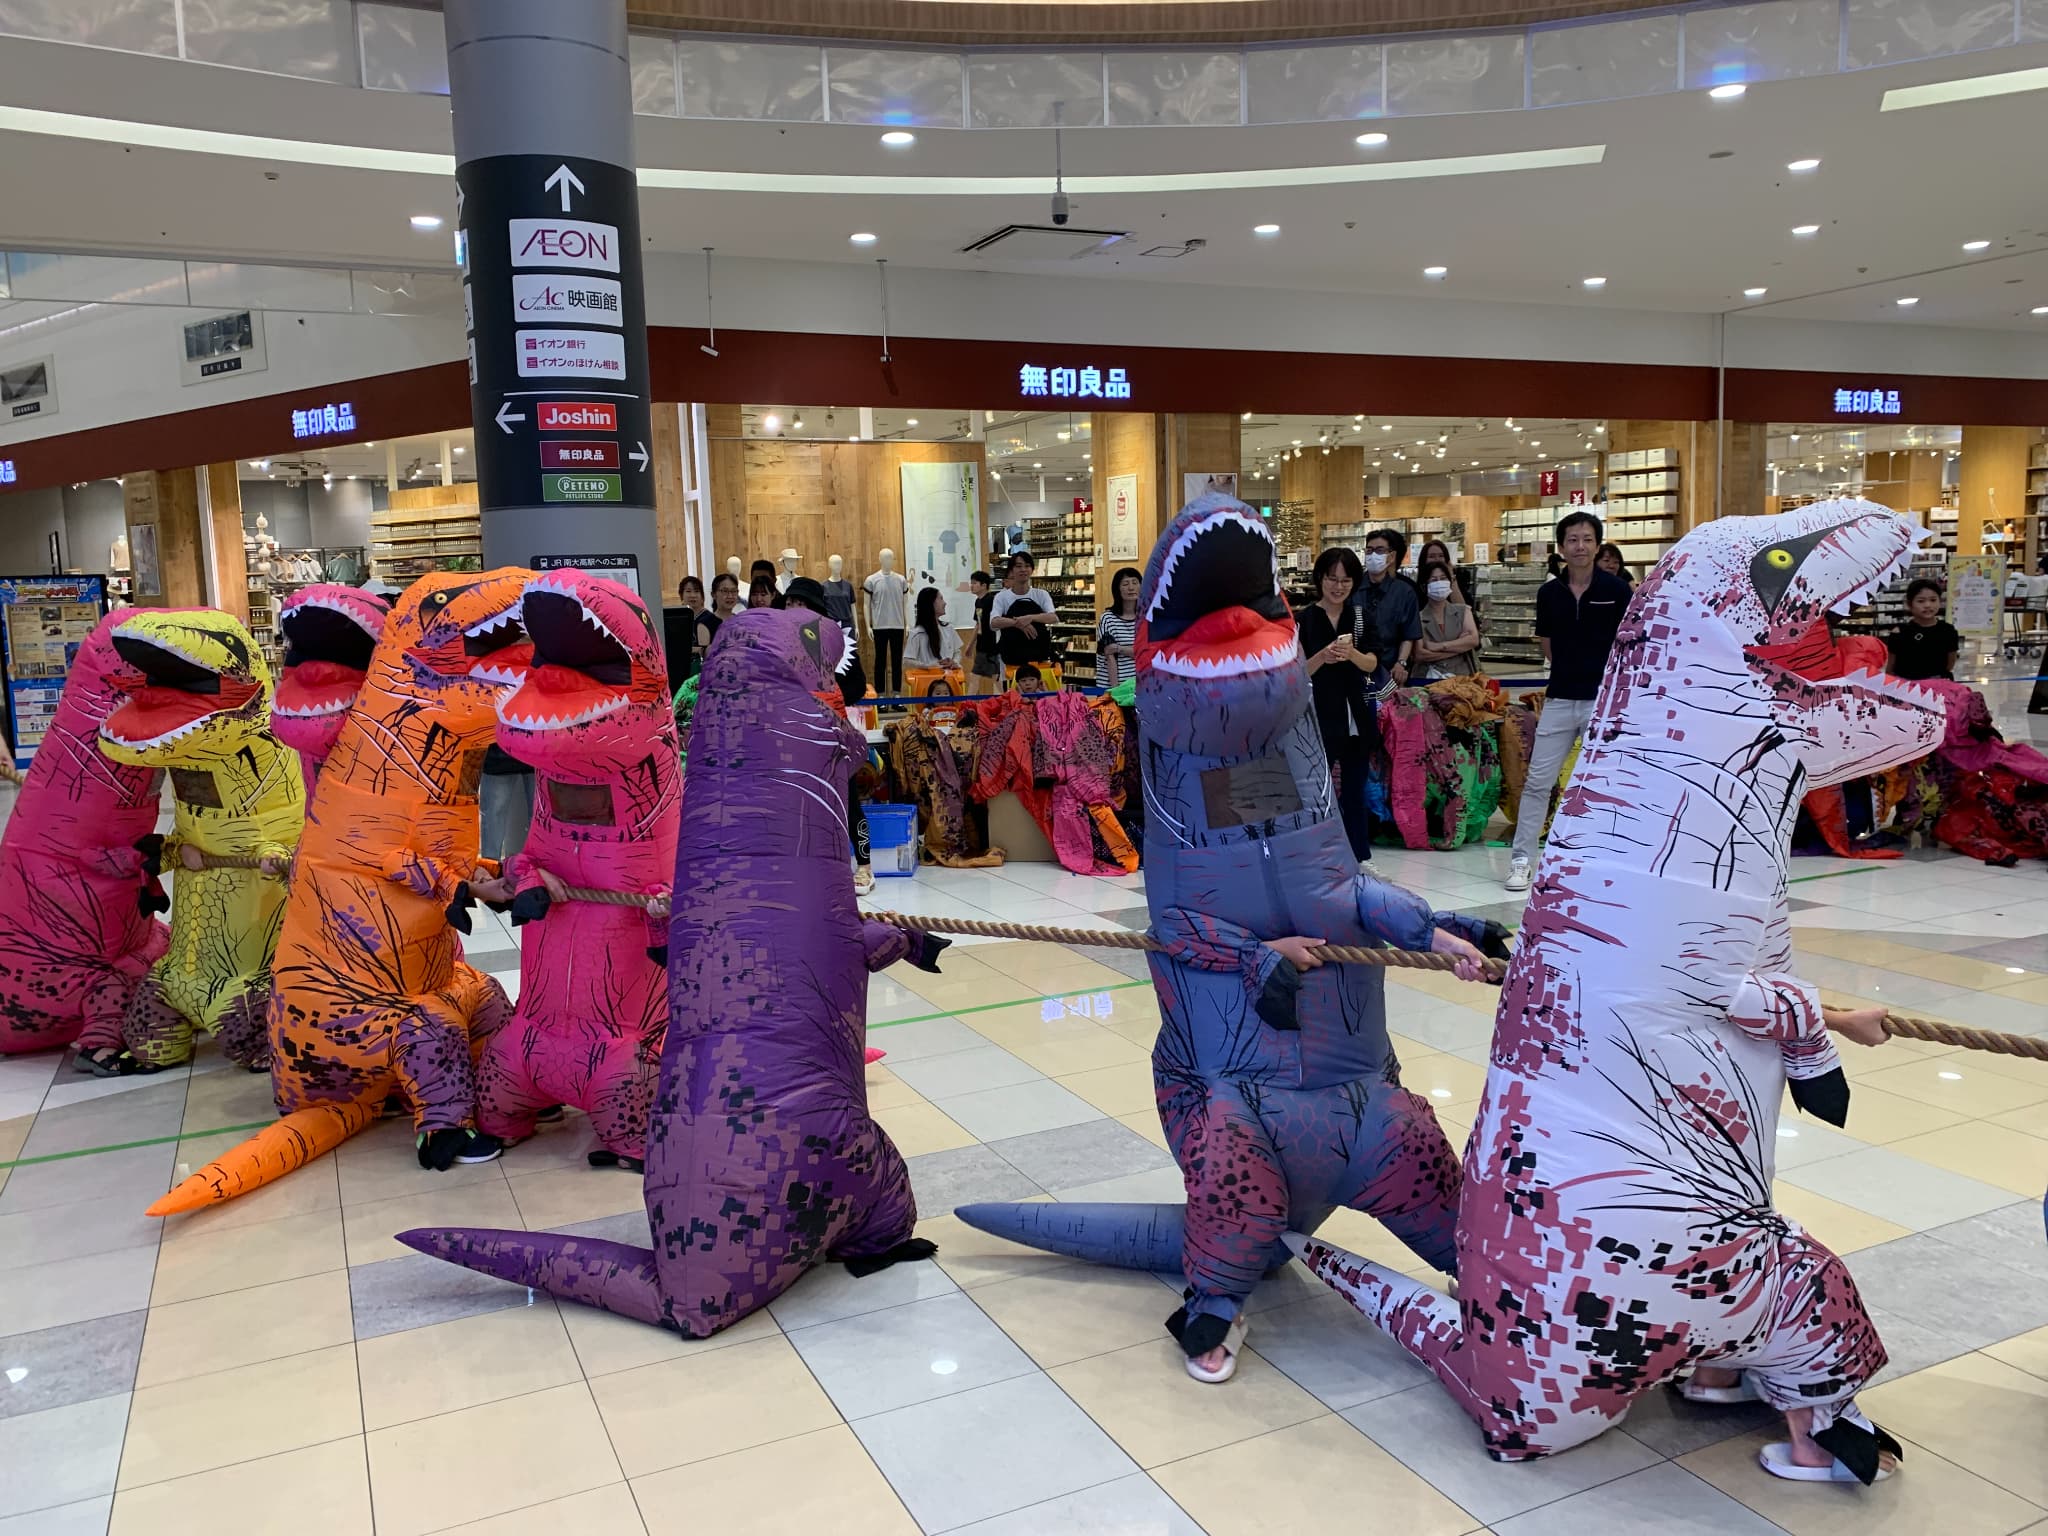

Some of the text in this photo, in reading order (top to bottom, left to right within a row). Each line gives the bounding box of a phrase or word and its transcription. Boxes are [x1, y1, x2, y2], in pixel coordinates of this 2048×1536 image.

[567, 289, 618, 312] 映画館
[538, 339, 586, 350] イオン銀行
[1019, 363, 1131, 399] 無印良品
[1833, 387, 1902, 414] 無印良品
[291, 402, 357, 439] 無印良品
[545, 407, 612, 425] Joshin
[558, 448, 605, 461] 無印良品
[563, 481, 605, 491] PETEMO
[551, 559, 562, 567] JR
